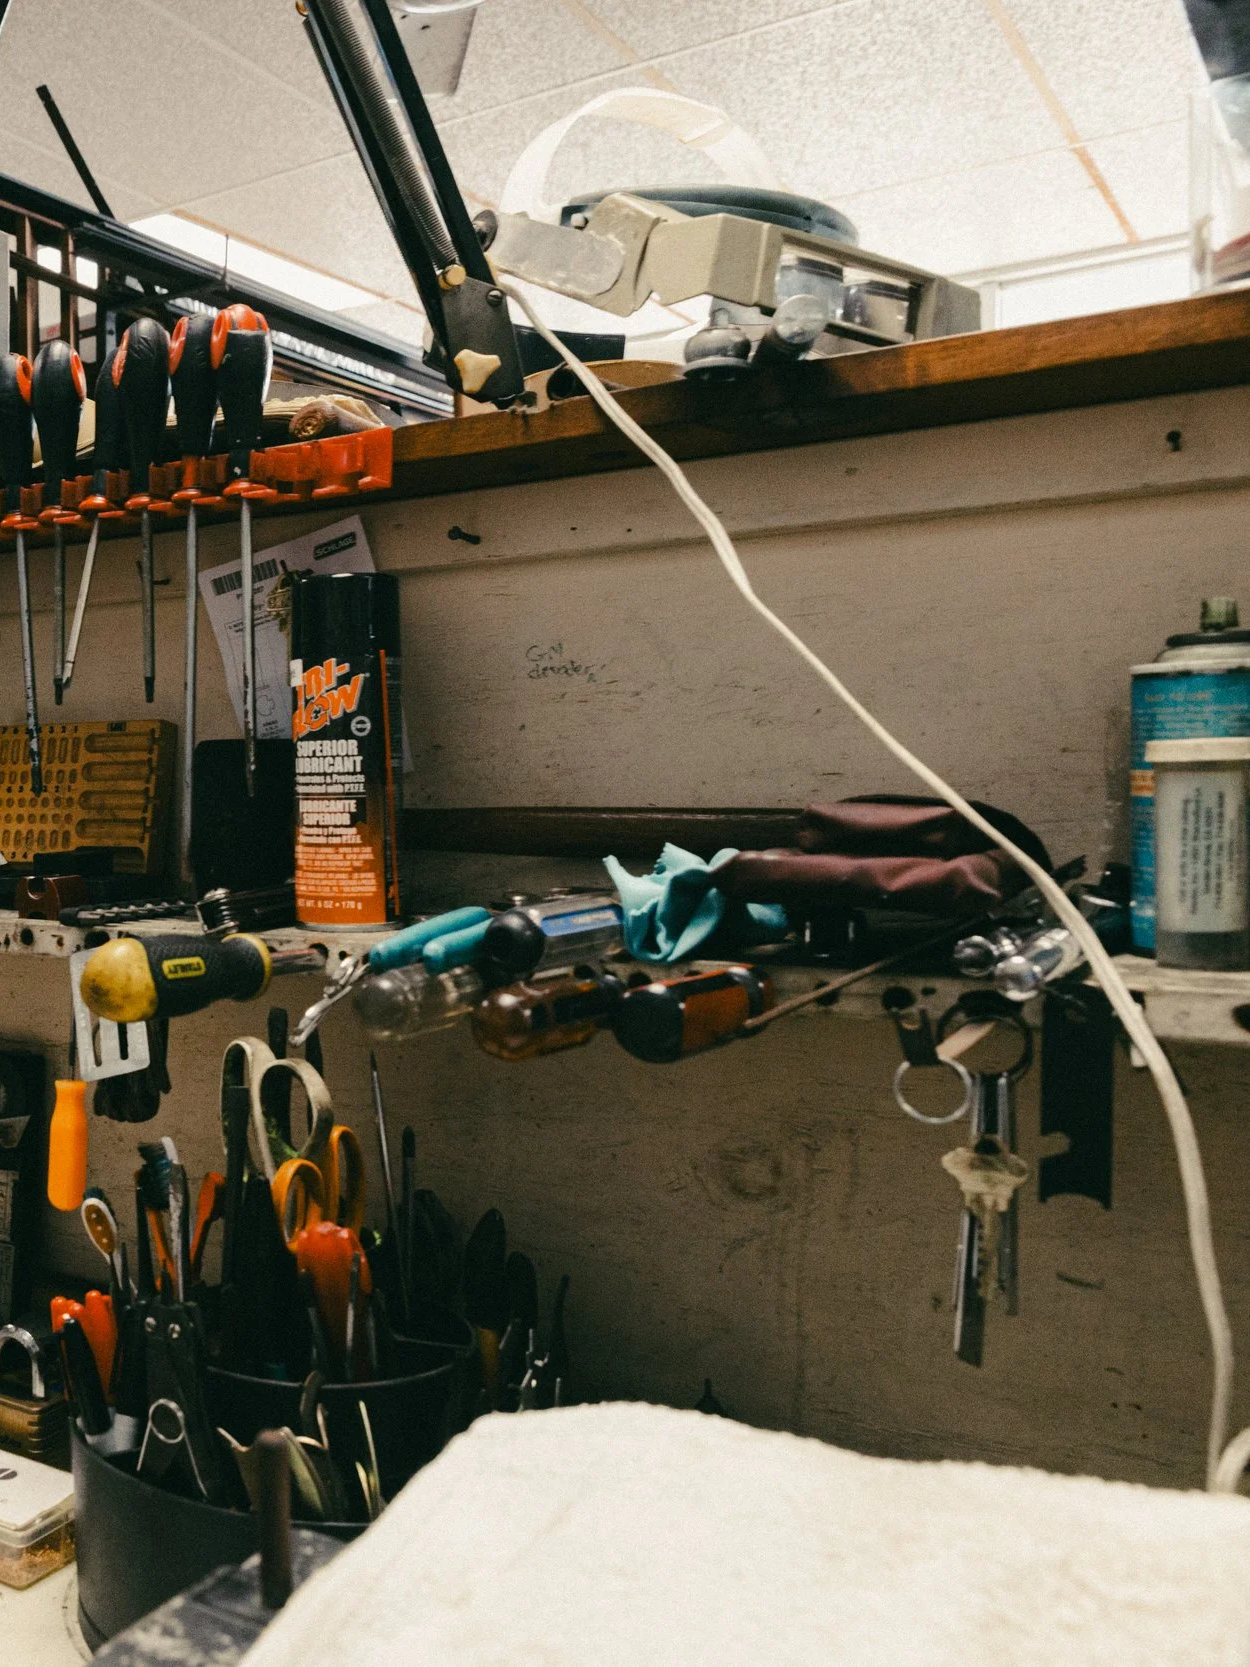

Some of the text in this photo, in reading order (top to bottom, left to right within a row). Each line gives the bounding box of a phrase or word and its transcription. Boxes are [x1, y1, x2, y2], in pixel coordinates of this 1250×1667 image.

[316, 535, 356, 557] SCHLAGE
[296, 739, 358, 757] SUPERIOR
[295, 756, 363, 774] UBRICANT
